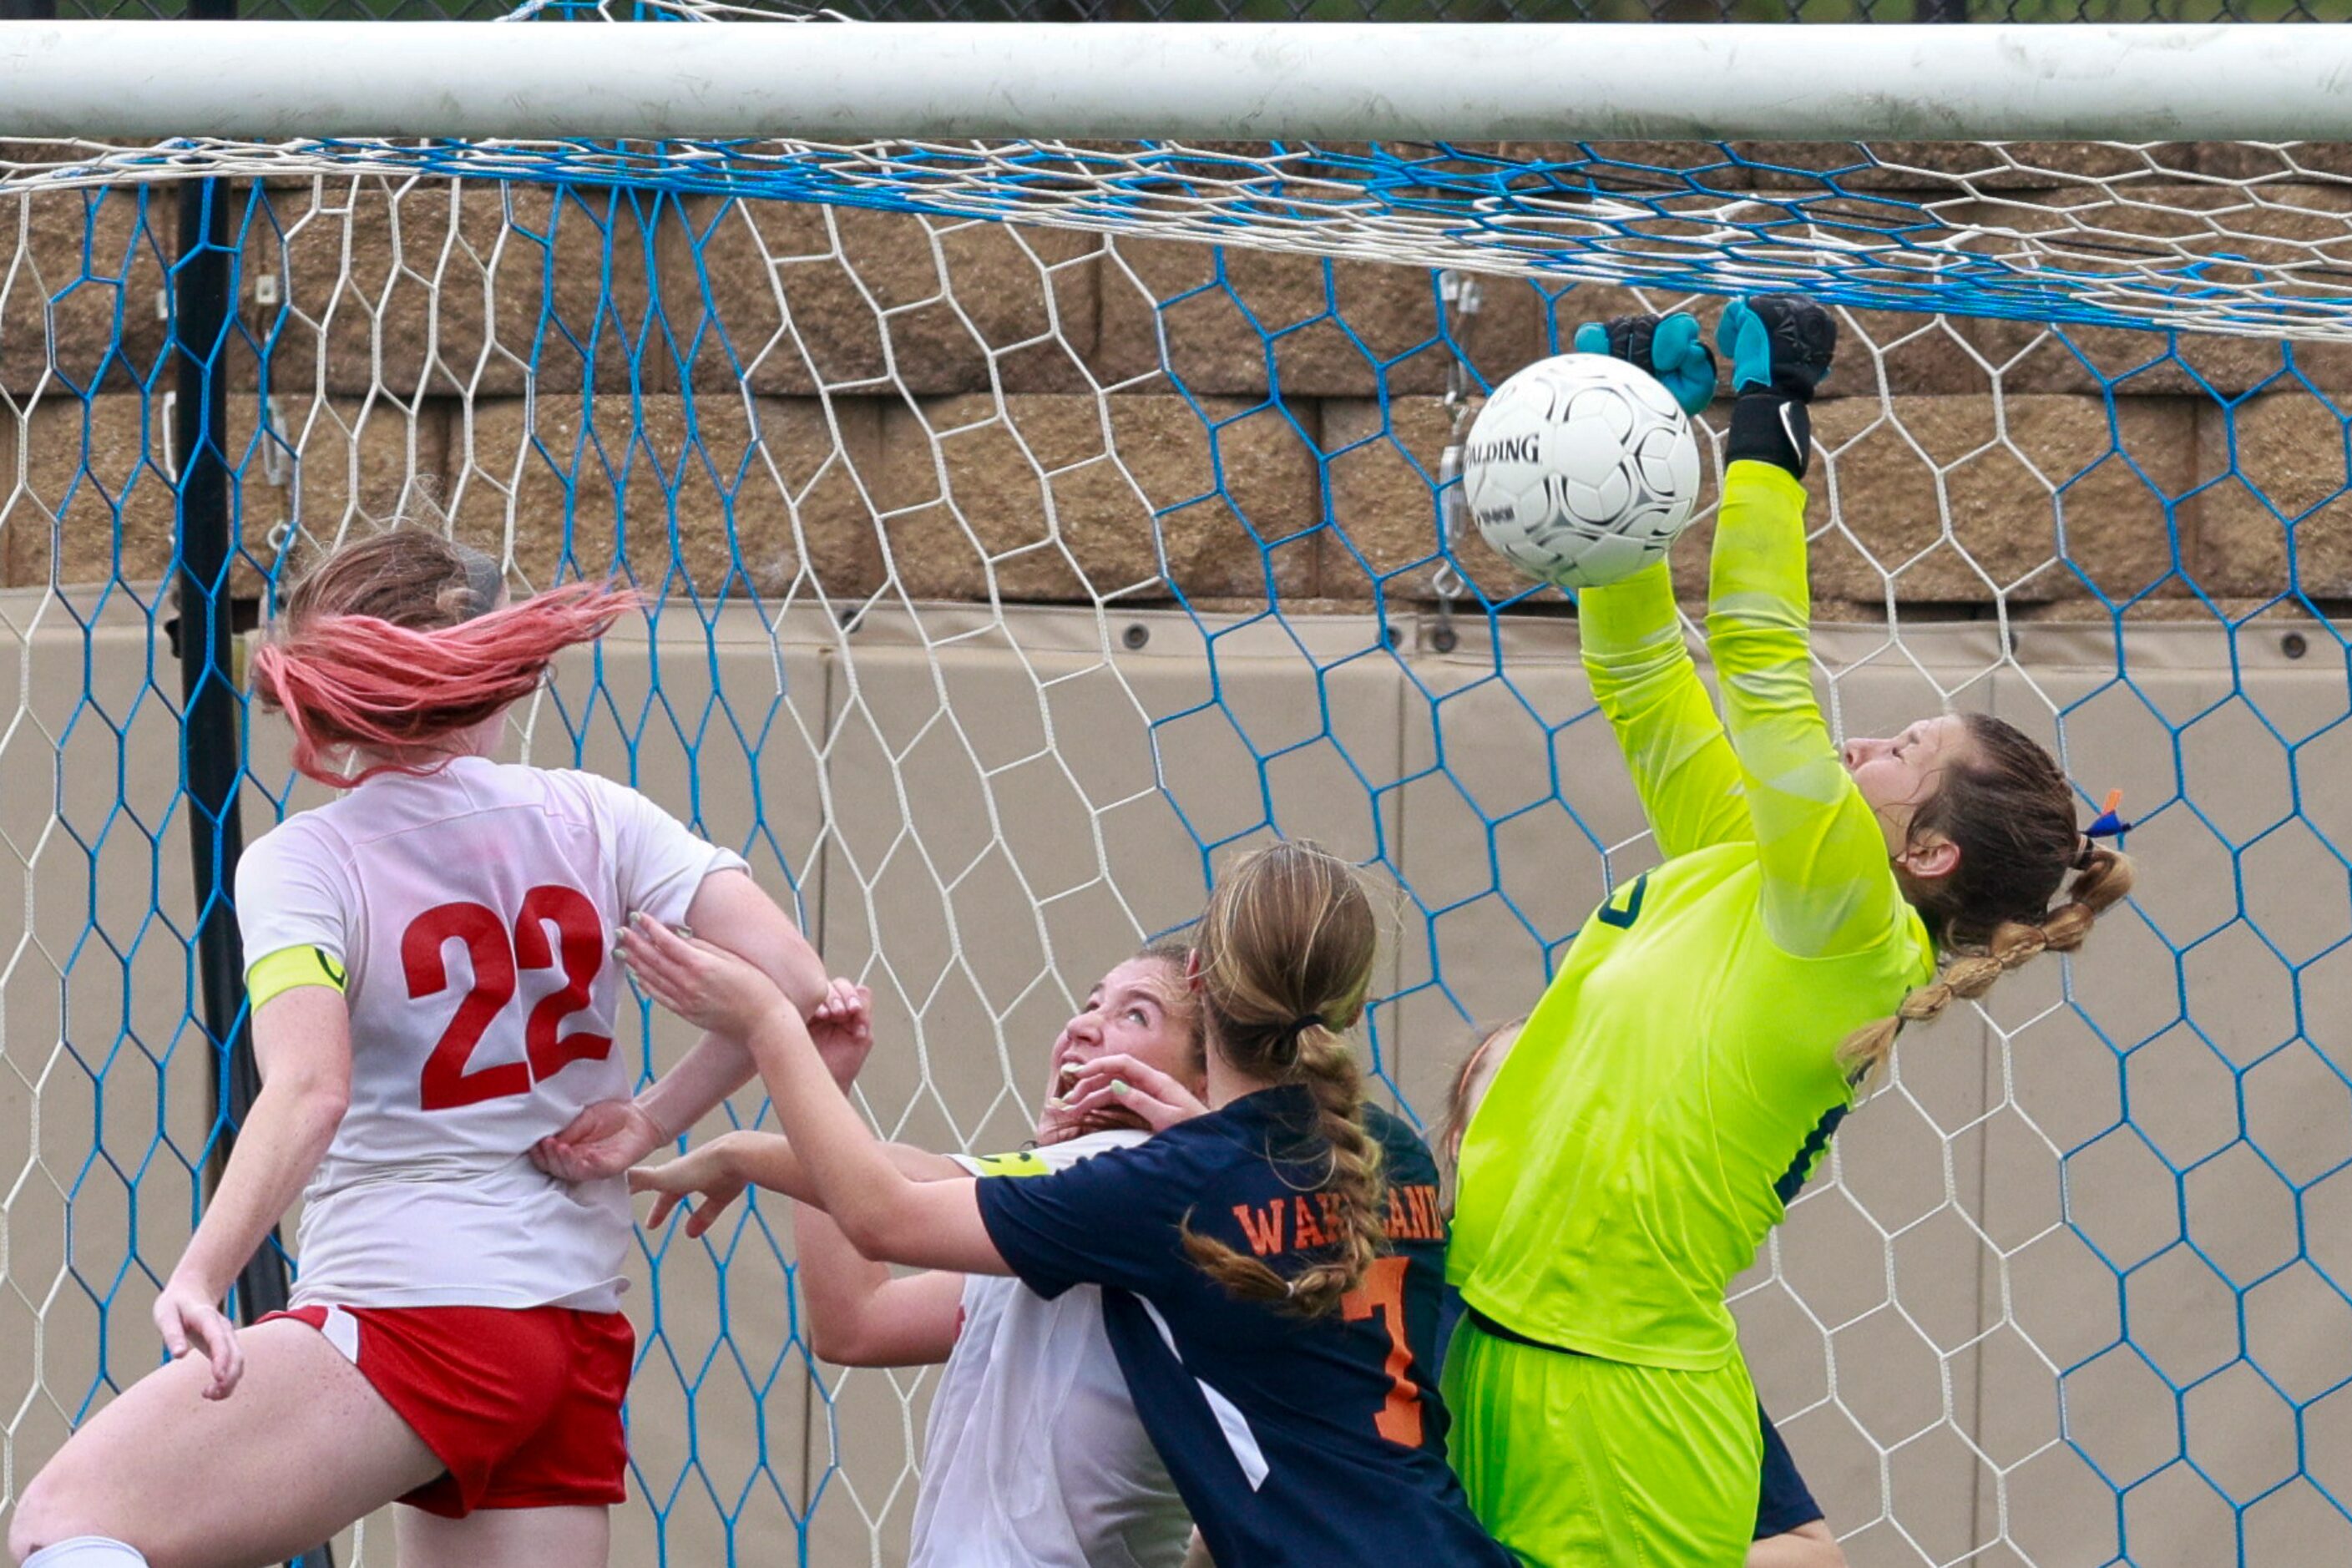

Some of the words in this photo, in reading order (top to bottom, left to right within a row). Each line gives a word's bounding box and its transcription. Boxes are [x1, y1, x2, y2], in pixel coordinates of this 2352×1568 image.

[1464, 432, 1540, 469] PALDING
[401, 884, 612, 1110] 22
[1340, 1257, 1425, 1449] 7
